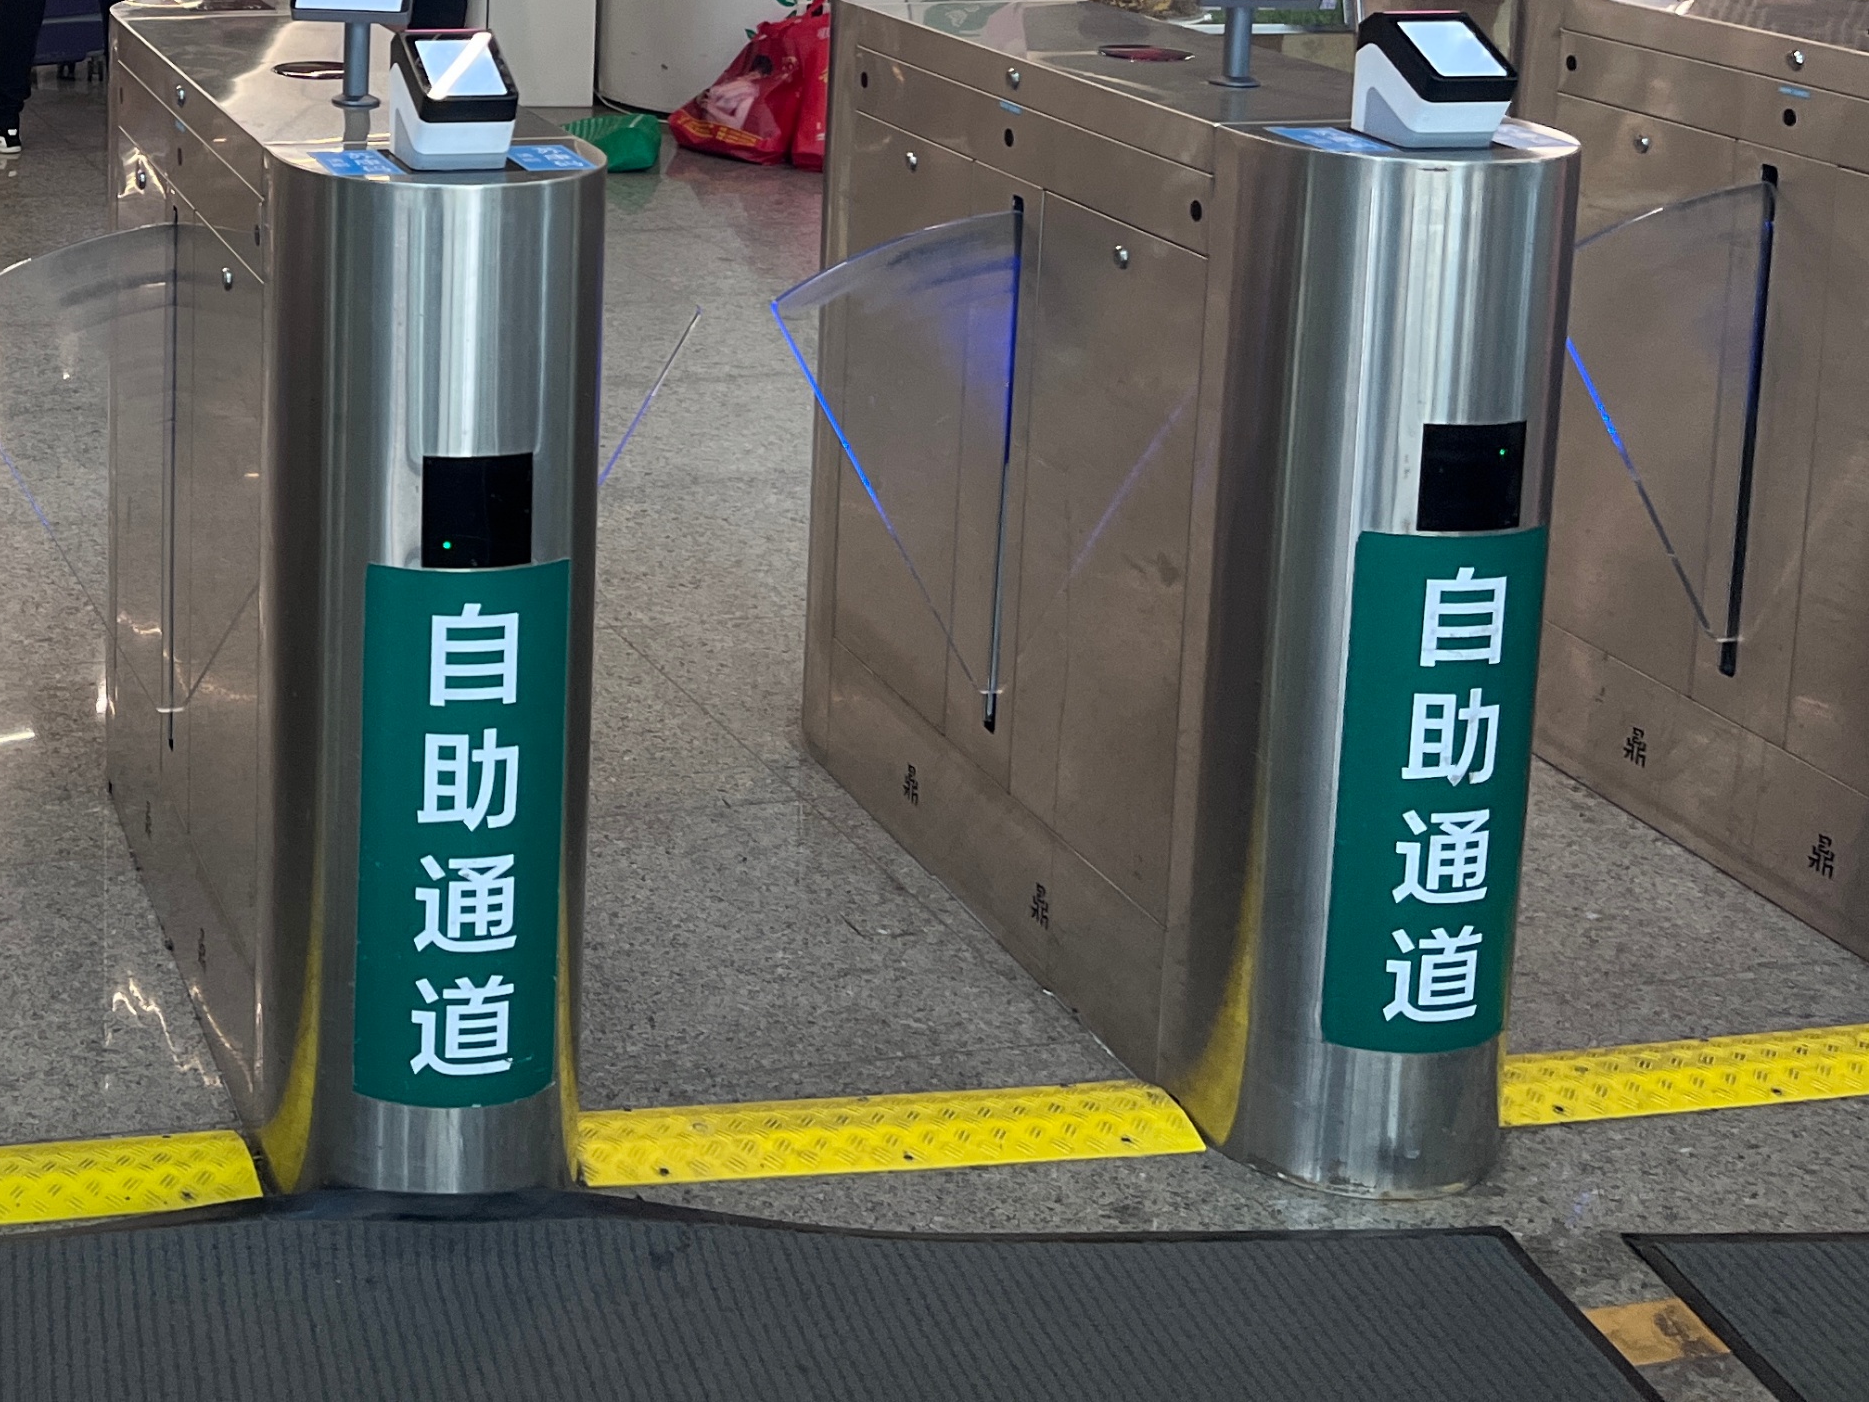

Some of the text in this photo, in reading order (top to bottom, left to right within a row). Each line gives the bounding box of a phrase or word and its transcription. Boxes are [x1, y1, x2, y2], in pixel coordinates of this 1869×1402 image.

[410, 603, 520, 1077] 自助通道
[1383, 566, 1508, 1023] 自助通道
